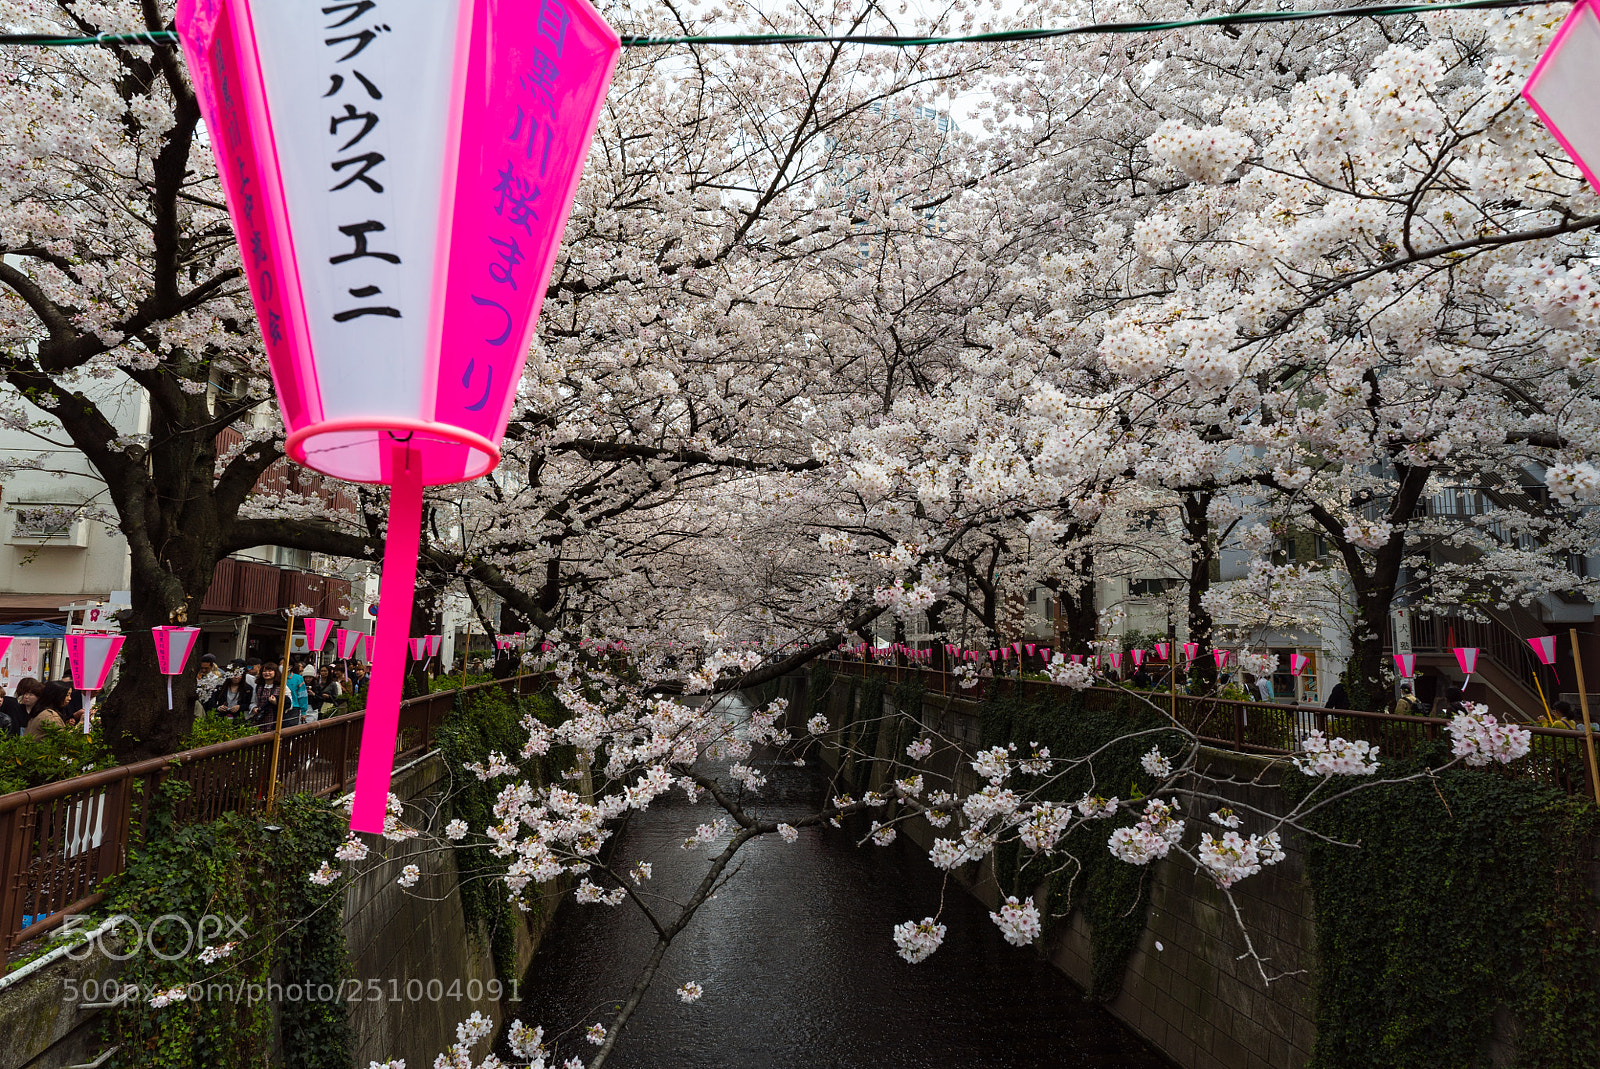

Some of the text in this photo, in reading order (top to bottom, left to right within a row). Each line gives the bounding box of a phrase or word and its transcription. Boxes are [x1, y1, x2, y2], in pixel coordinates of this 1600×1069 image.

[463, 0, 570, 411] 目黒川桜まつり
